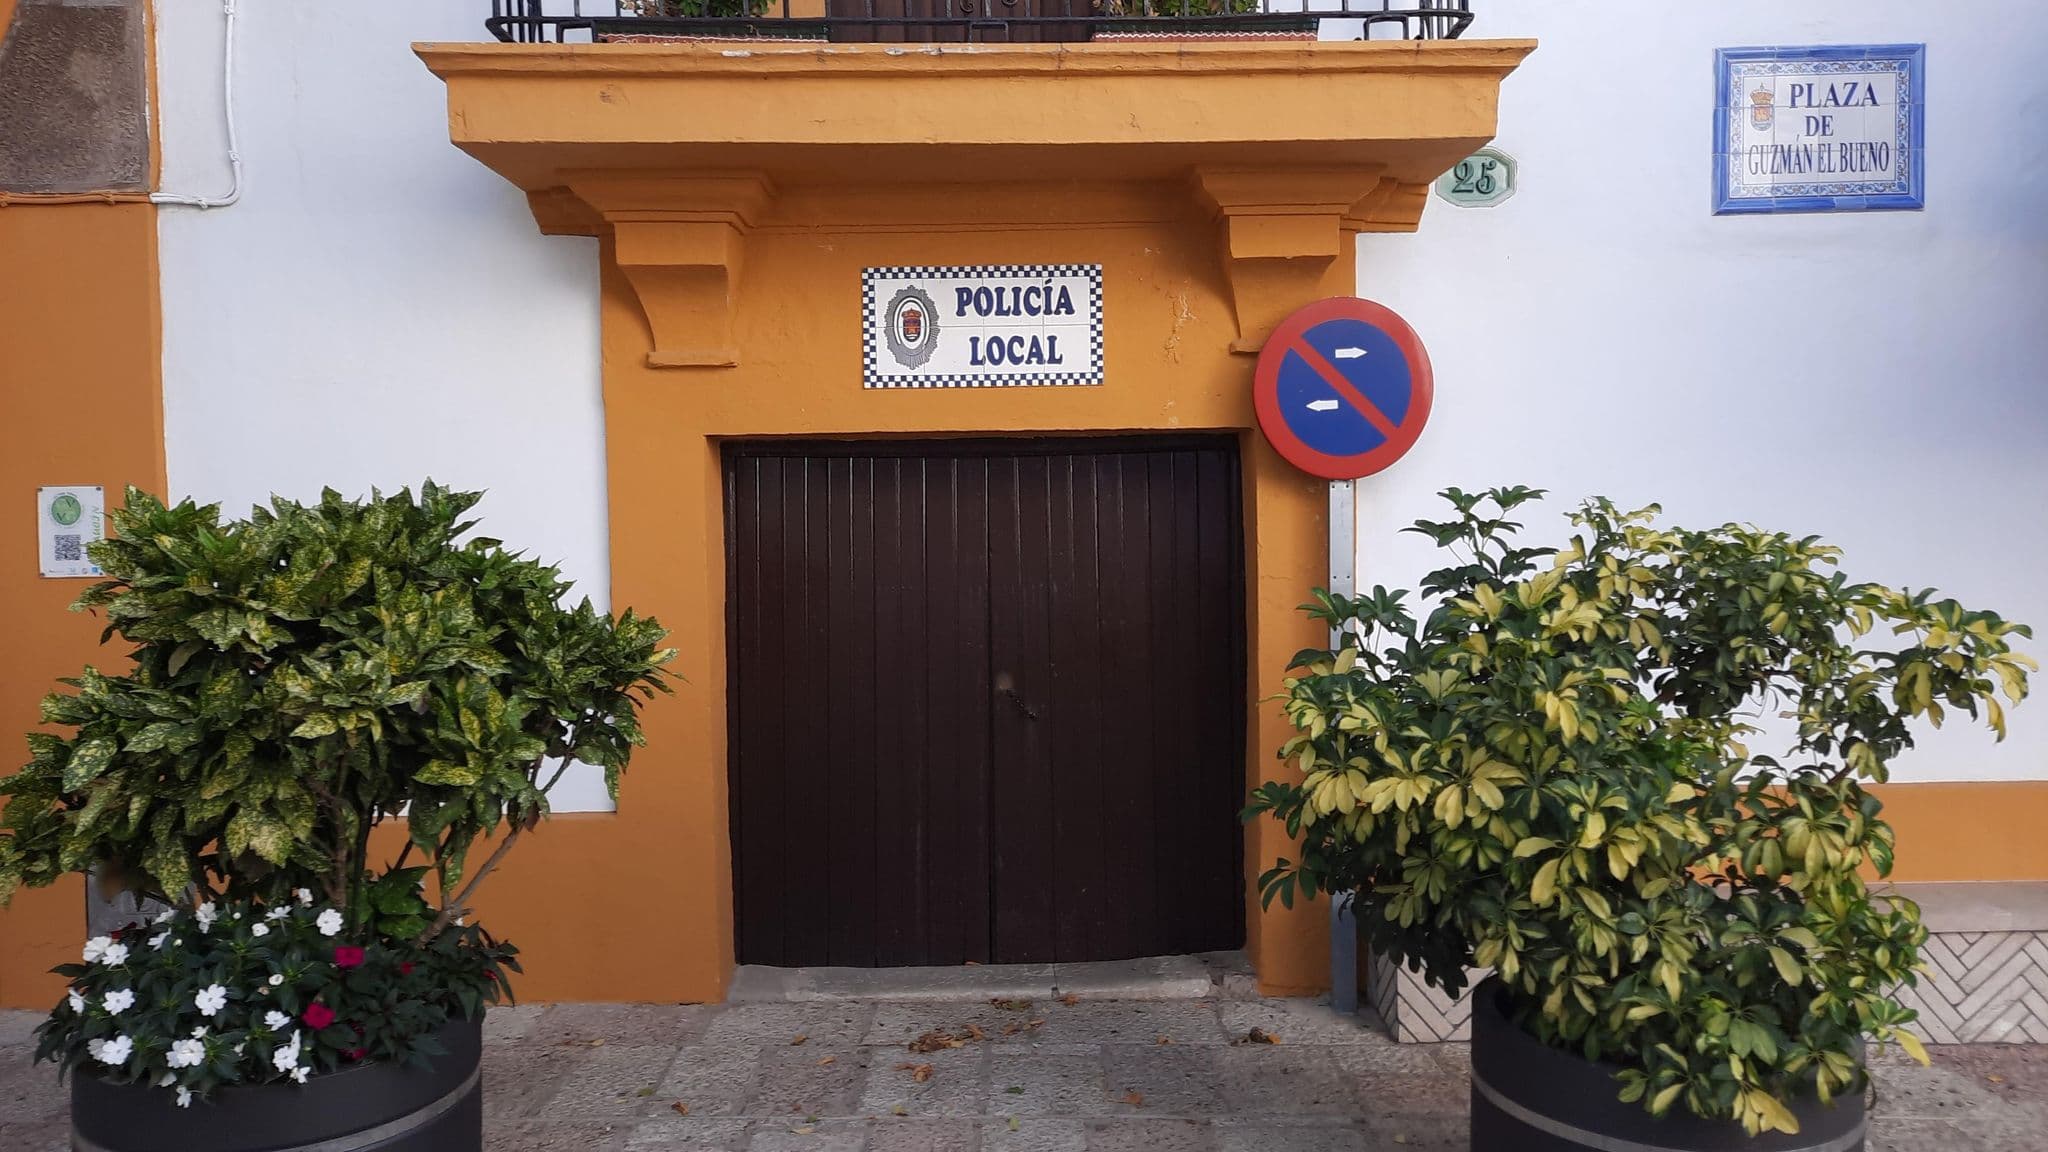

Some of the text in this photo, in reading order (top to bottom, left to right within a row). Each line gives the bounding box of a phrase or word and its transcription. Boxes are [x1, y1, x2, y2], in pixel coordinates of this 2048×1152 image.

[1789, 82, 1880, 109] PLAZA
[1805, 115, 1834, 137] DE
[1748, 135, 1890, 175] GUZMÁN EL BUENO
[1451, 160, 1497, 195] 25
[955, 279, 1076, 317] POLICÍA
[969, 335, 1063, 366] LOCAL
